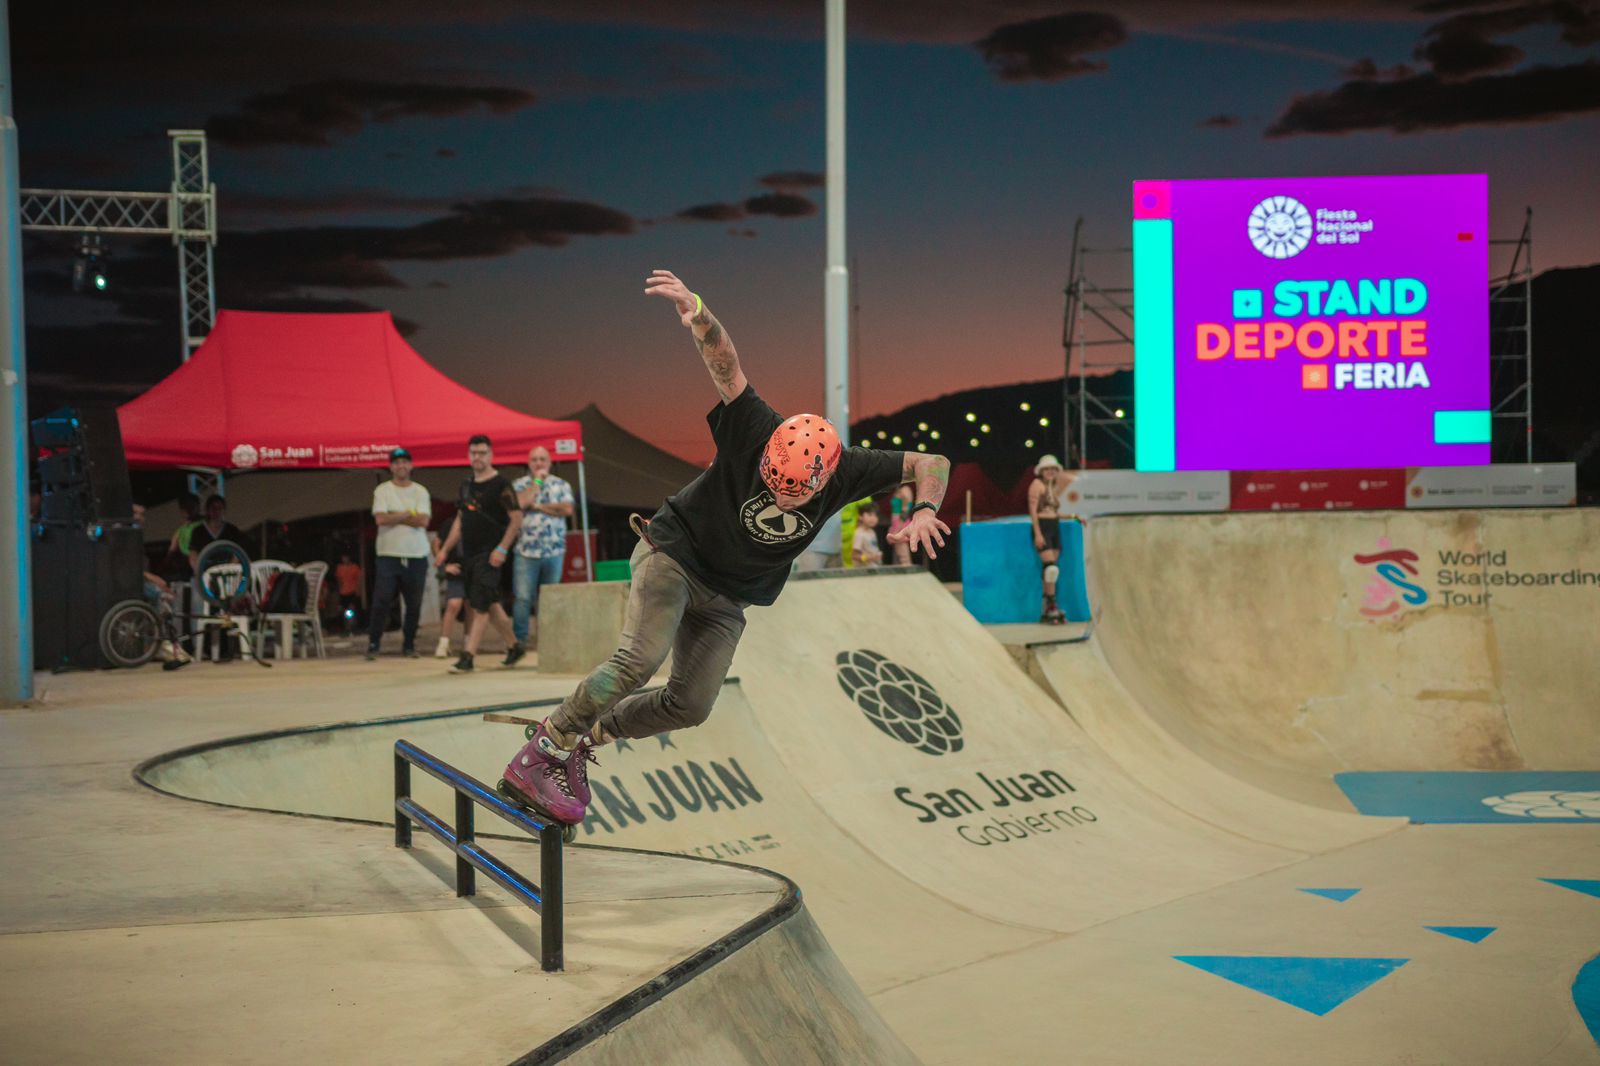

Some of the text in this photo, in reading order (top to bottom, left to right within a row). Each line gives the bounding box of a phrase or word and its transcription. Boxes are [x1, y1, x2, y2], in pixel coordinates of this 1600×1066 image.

[1316, 208, 1357, 221] Fiesta
[1316, 219, 1373, 232] Nacional
[1316, 232, 1360, 244] del Sol
[1273, 277, 1428, 317] STAND
[1196, 320, 1428, 360] DEPORTE
[1334, 362, 1431, 390] FERIA
[260, 446, 314, 458] San Juan
[1438, 550, 1507, 567] World
[1439, 589, 1493, 607] Tour
[581, 756, 764, 836] AN JUAN
[894, 769, 1077, 823] San Juan
[957, 805, 1098, 847] Gobierno
